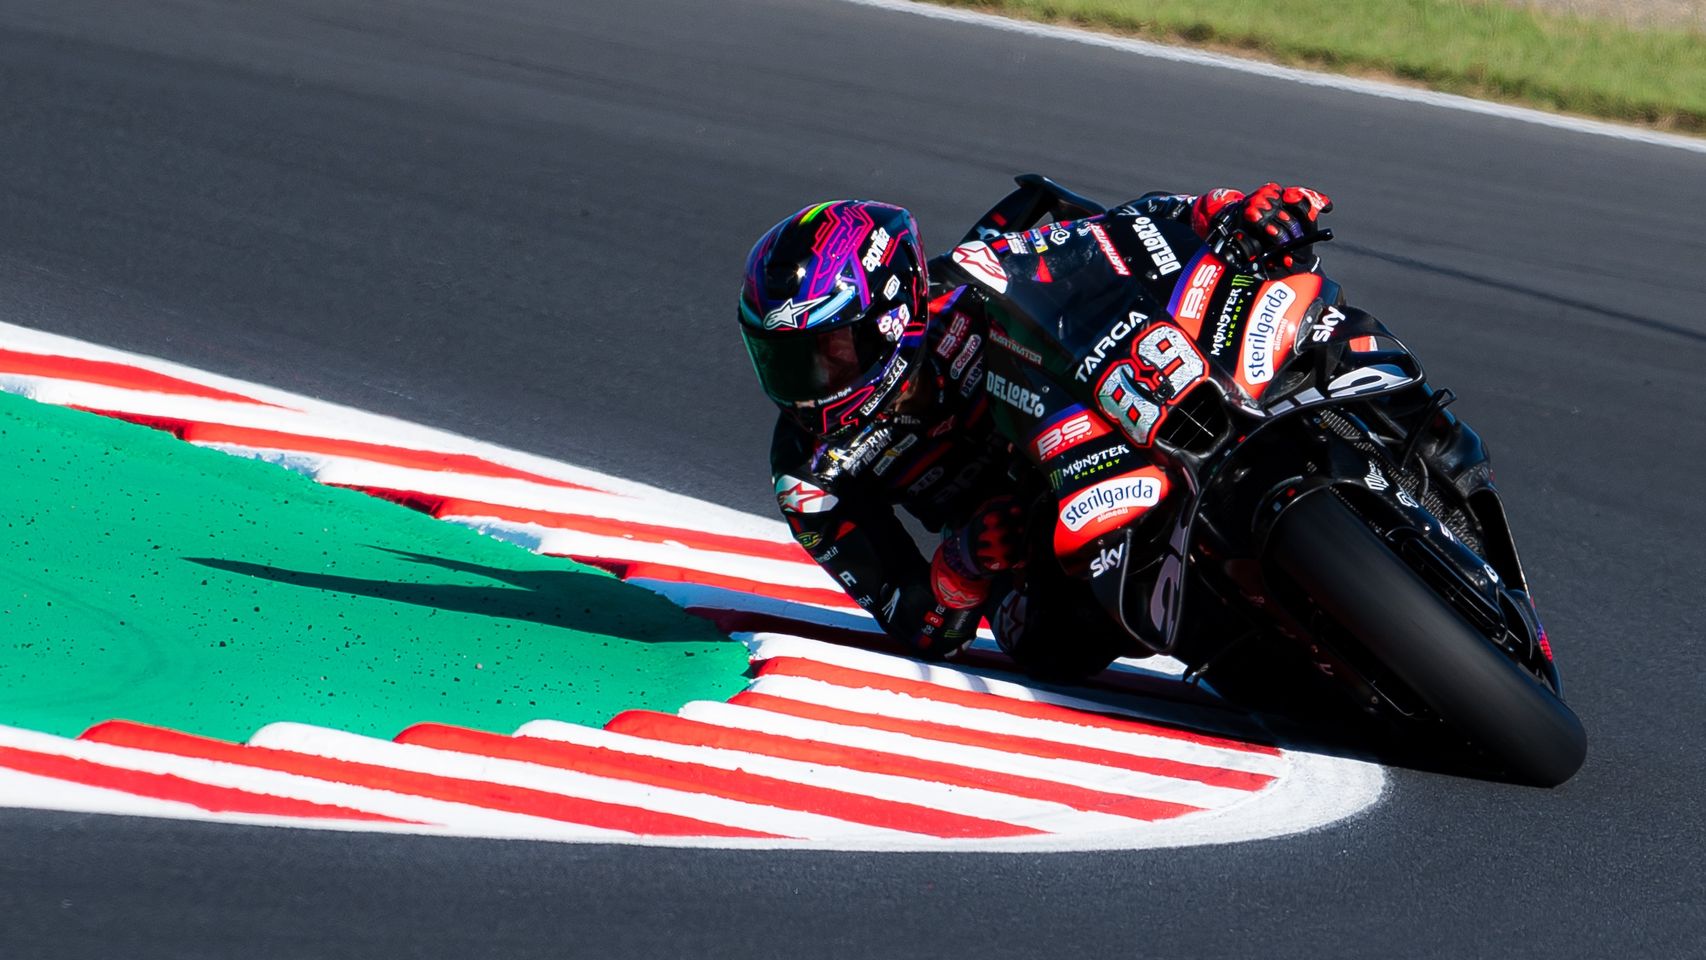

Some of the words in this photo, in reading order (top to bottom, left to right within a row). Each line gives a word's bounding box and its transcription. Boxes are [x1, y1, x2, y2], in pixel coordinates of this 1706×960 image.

[1180, 264, 1216, 318] BS
[1211, 288, 1242, 356] MONSTER
[1225, 299, 1244, 347] ENERGY
[1248, 288, 1288, 378] sterilgarda
[1312, 306, 1346, 342] sky
[1075, 311, 1148, 383] TARGA
[1094, 321, 1209, 448] 89
[1037, 415, 1092, 456] BS
[1062, 444, 1130, 477] MONSTER
[1074, 458, 1121, 480] ENERGY
[1066, 480, 1154, 525] sterilgarda
[1089, 542, 1126, 579] sky
